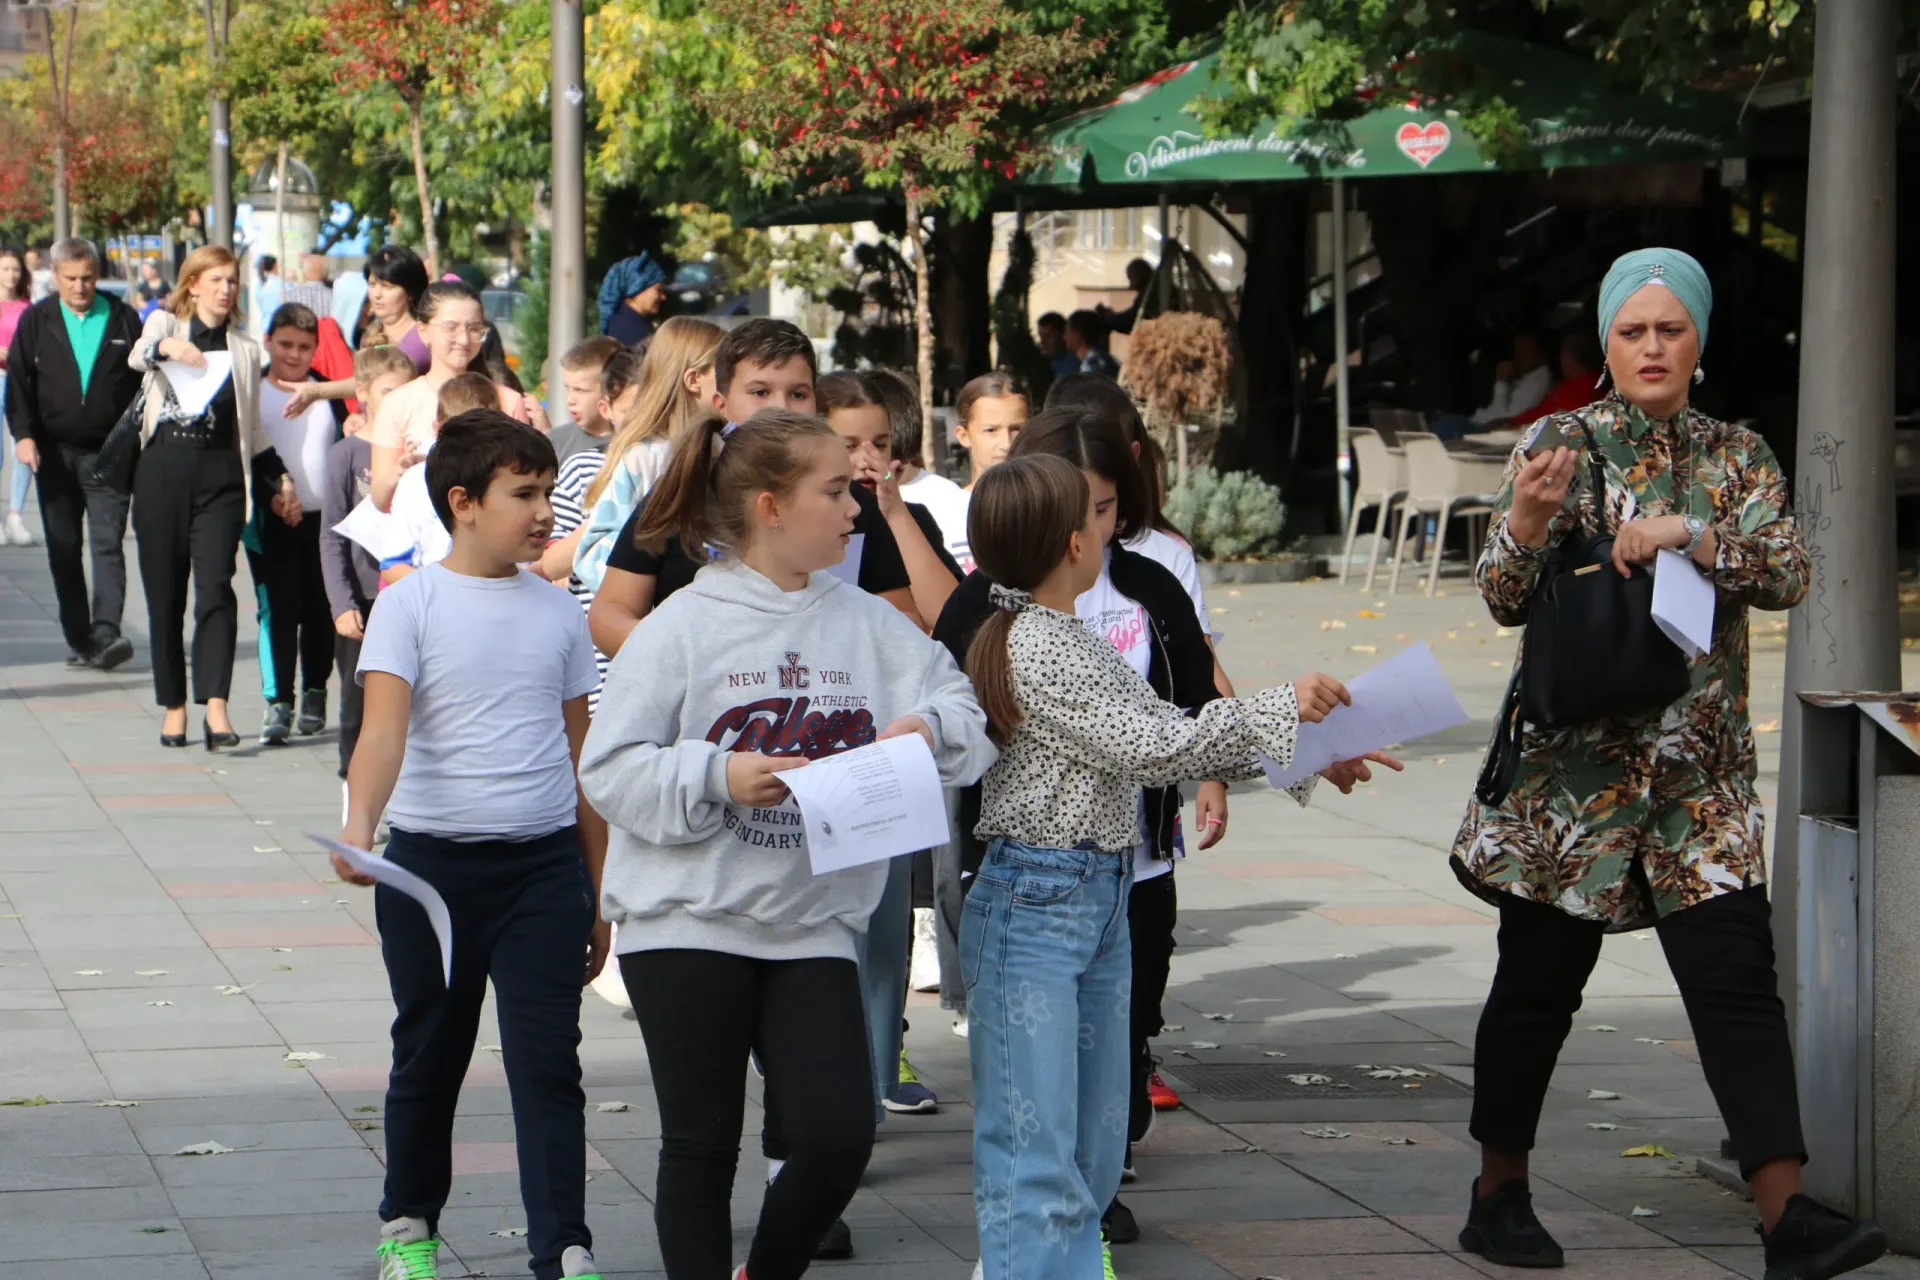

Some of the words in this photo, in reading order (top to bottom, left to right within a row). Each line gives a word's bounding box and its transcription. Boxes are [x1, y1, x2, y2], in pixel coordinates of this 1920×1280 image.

[1256, 131, 1296, 153] dar
[728, 671, 767, 688] NEW
[819, 670, 853, 686] YORK
[810, 695, 868, 708] ATHLETIC
[751, 808, 802, 826] BKLYN
